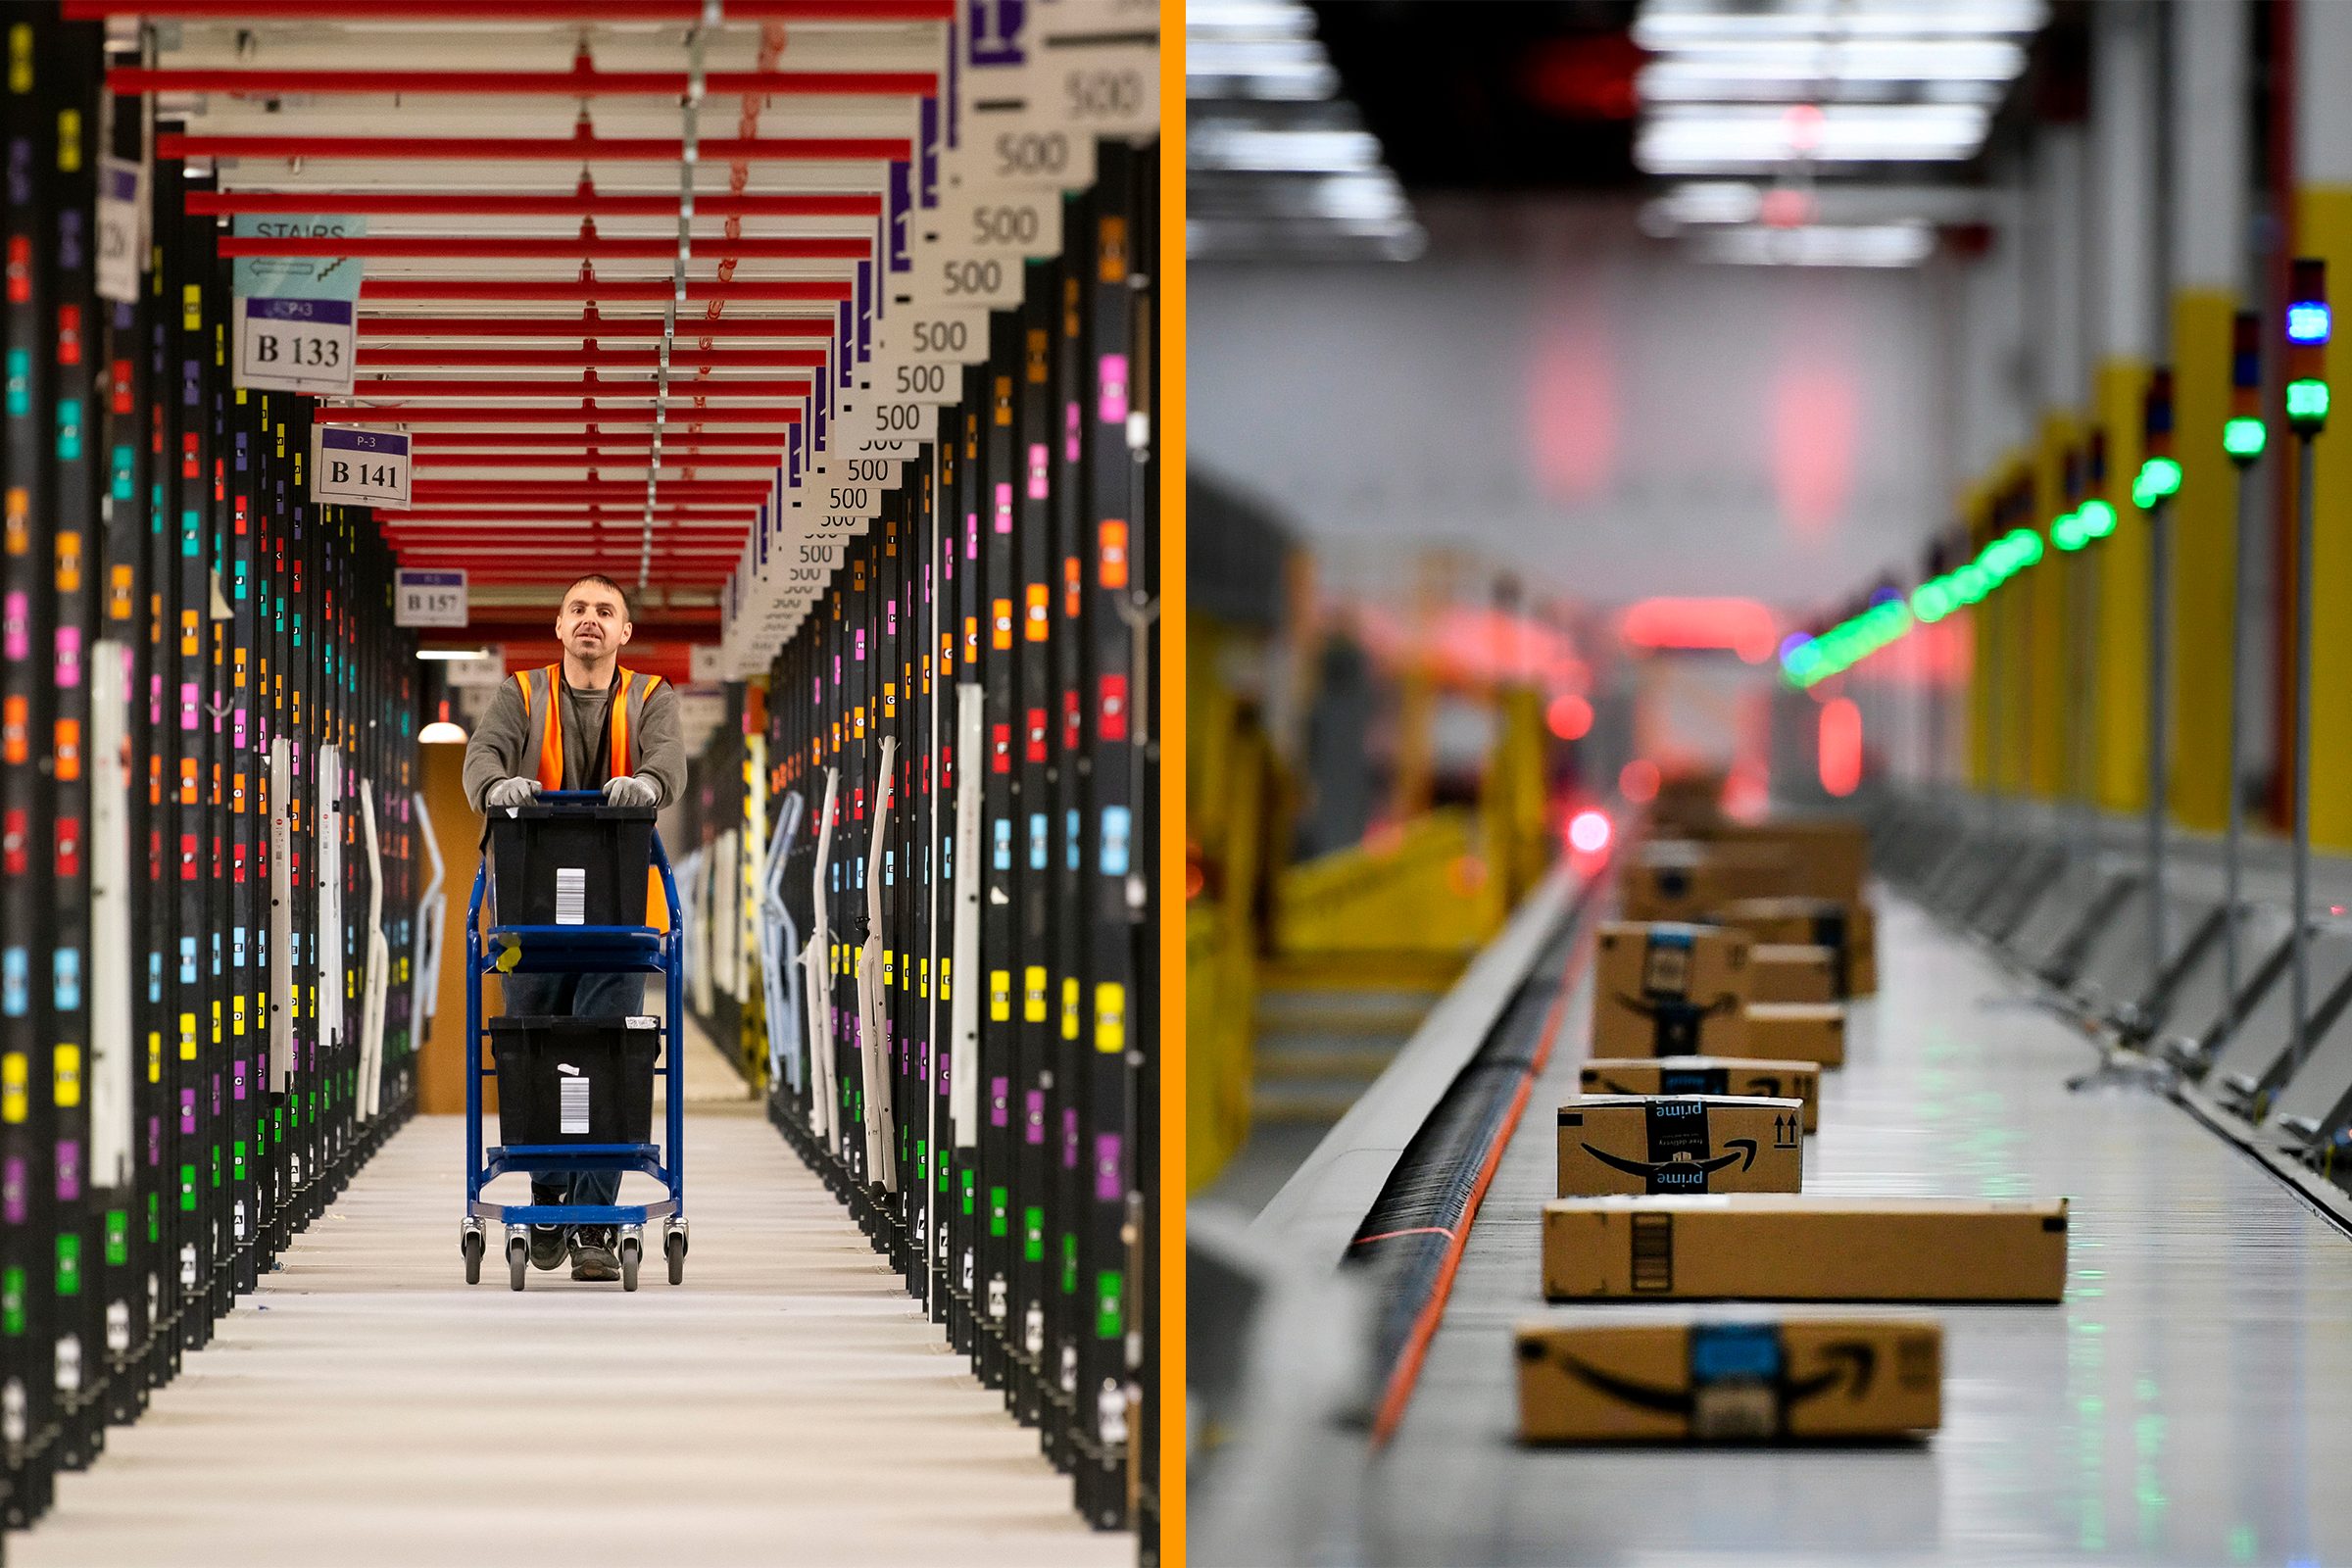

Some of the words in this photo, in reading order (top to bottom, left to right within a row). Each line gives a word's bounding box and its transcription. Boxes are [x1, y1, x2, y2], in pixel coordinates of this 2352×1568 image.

[996, 130, 1069, 176] 500
[973, 205, 1039, 245] 500
[944, 260, 1003, 295] 500
[913, 321, 966, 352] 500
[257, 335, 279, 363] B
[292, 338, 339, 368] 133
[897, 366, 945, 393] 500
[876, 404, 919, 431] 500
[357, 436, 376, 448] P-3
[330, 461, 350, 483] B
[359, 464, 397, 488] 141
[848, 459, 889, 481] 500
[829, 488, 867, 509] 500
[800, 545, 832, 564] 500
[408, 594, 420, 611] B
[429, 594, 457, 611] 157
[1656, 1100, 1702, 1119] prime
[1657, 1170, 1703, 1188] prime
